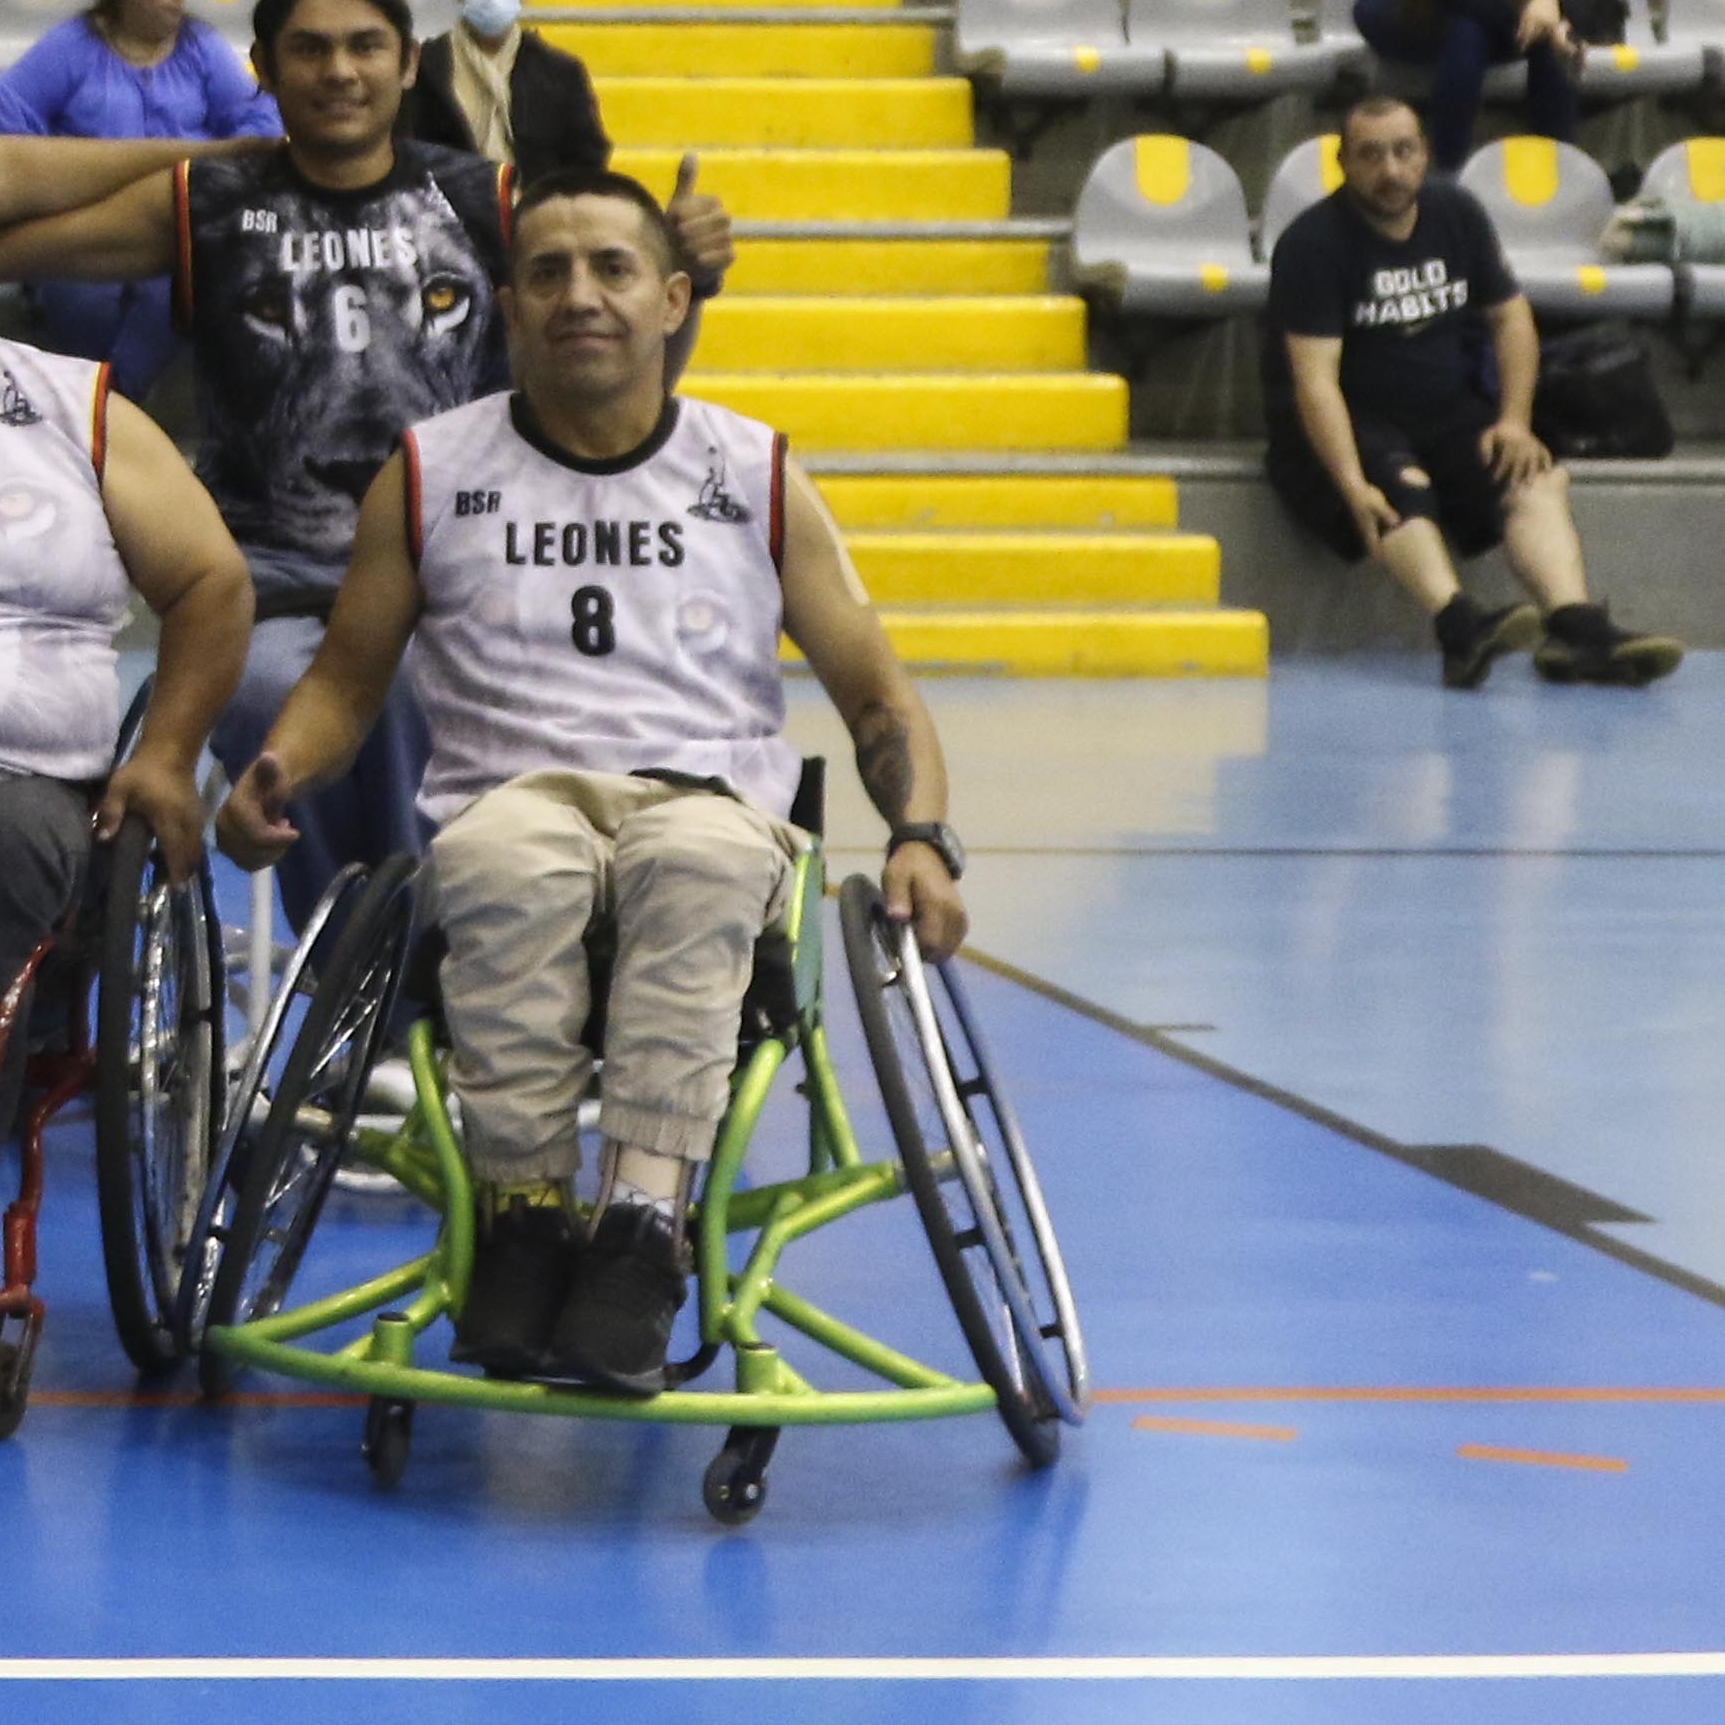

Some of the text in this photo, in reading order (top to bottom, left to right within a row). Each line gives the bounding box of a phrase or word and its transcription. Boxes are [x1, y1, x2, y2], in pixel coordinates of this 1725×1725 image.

[242, 209, 278, 233] BSR
[279, 226, 418, 272] LEONES
[334, 283, 371, 353] 6
[455, 490, 501, 518] BSR
[505, 520, 685, 567] LEONES
[570, 585, 616, 657] 8
